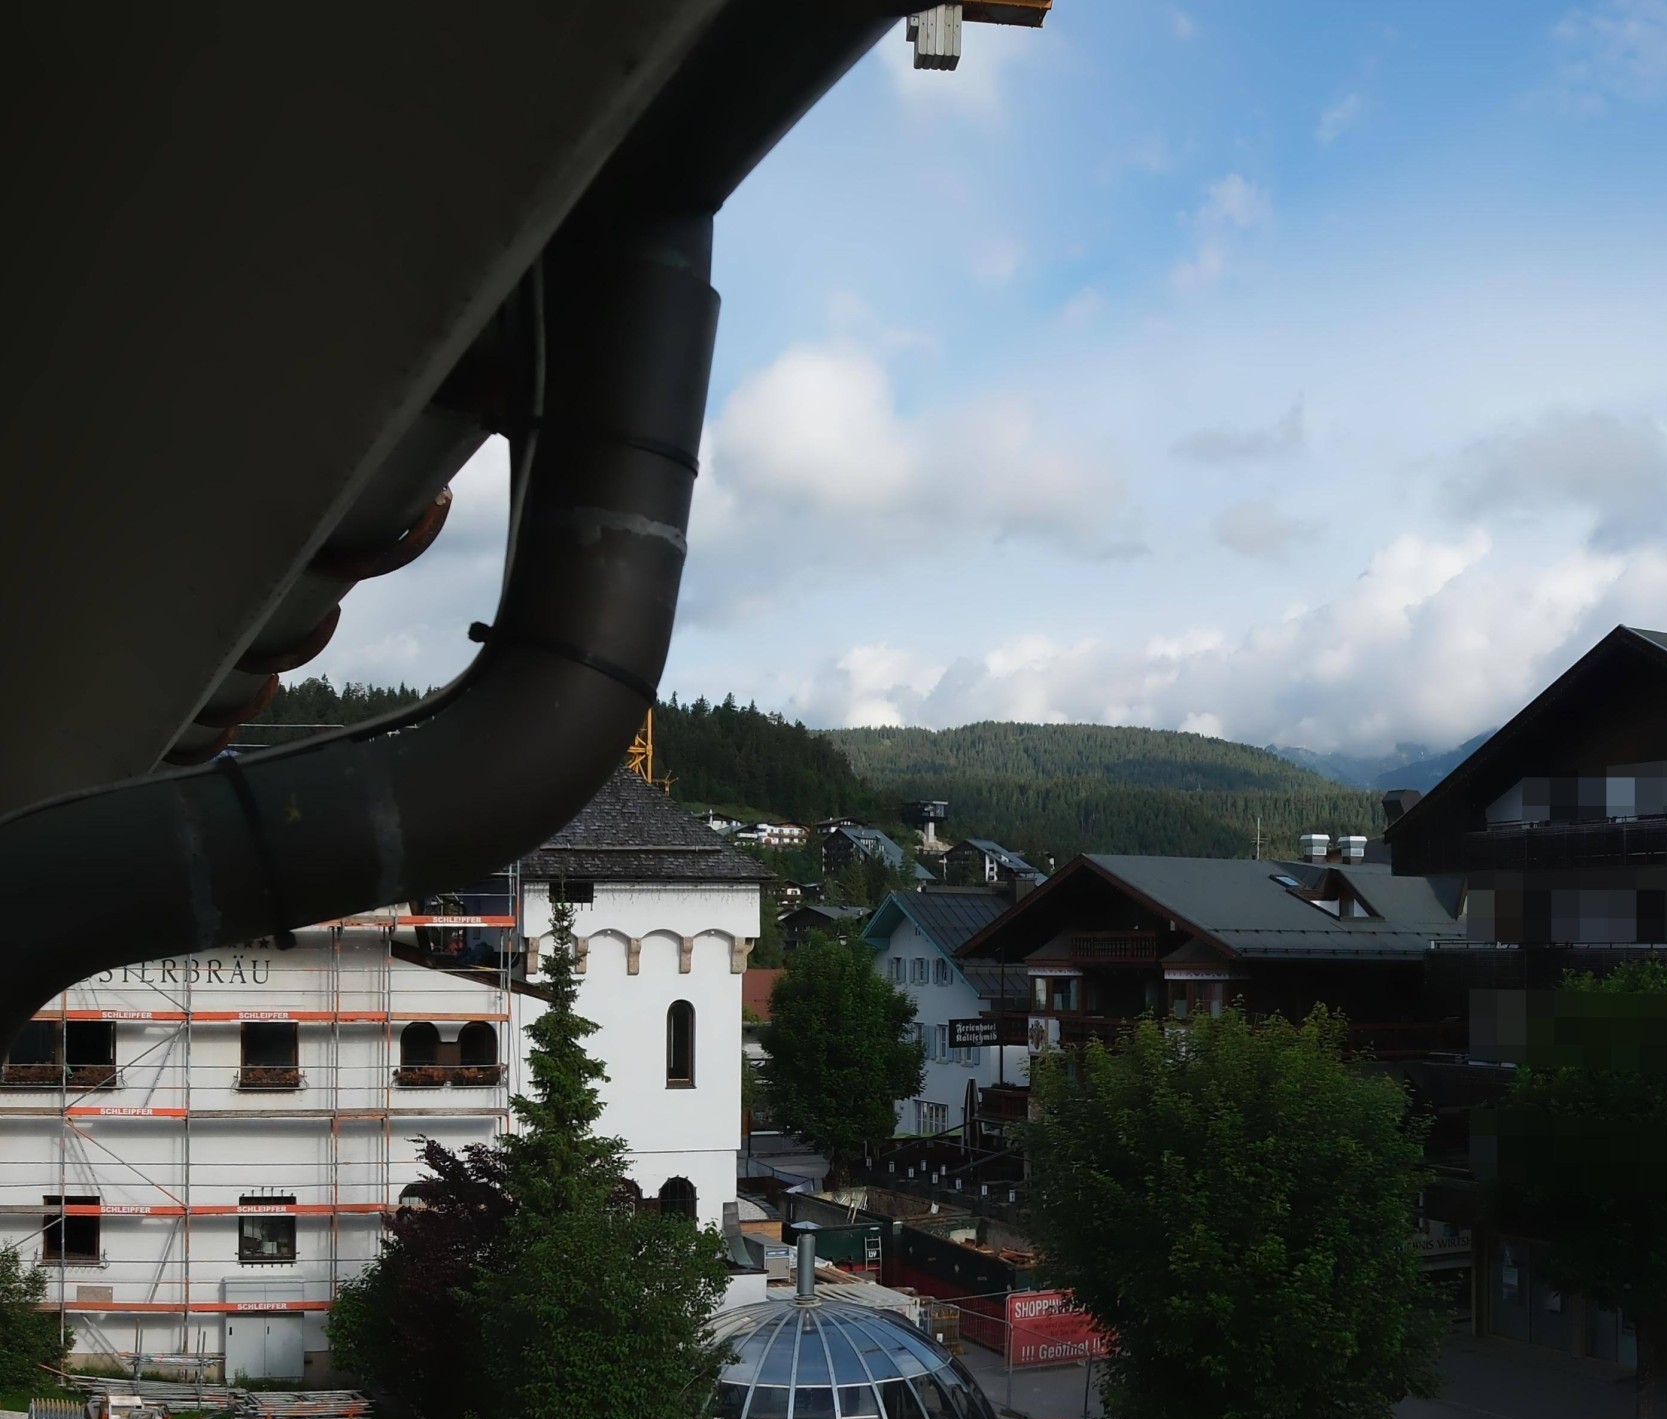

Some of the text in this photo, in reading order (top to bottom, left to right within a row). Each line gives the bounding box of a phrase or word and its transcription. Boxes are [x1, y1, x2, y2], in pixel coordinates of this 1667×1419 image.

[79, 955, 271, 984] STERBRÄU
[102, 1011, 152, 1019] SCHLEIPFER
[1015, 1299, 1065, 1318] SHOPPIN
